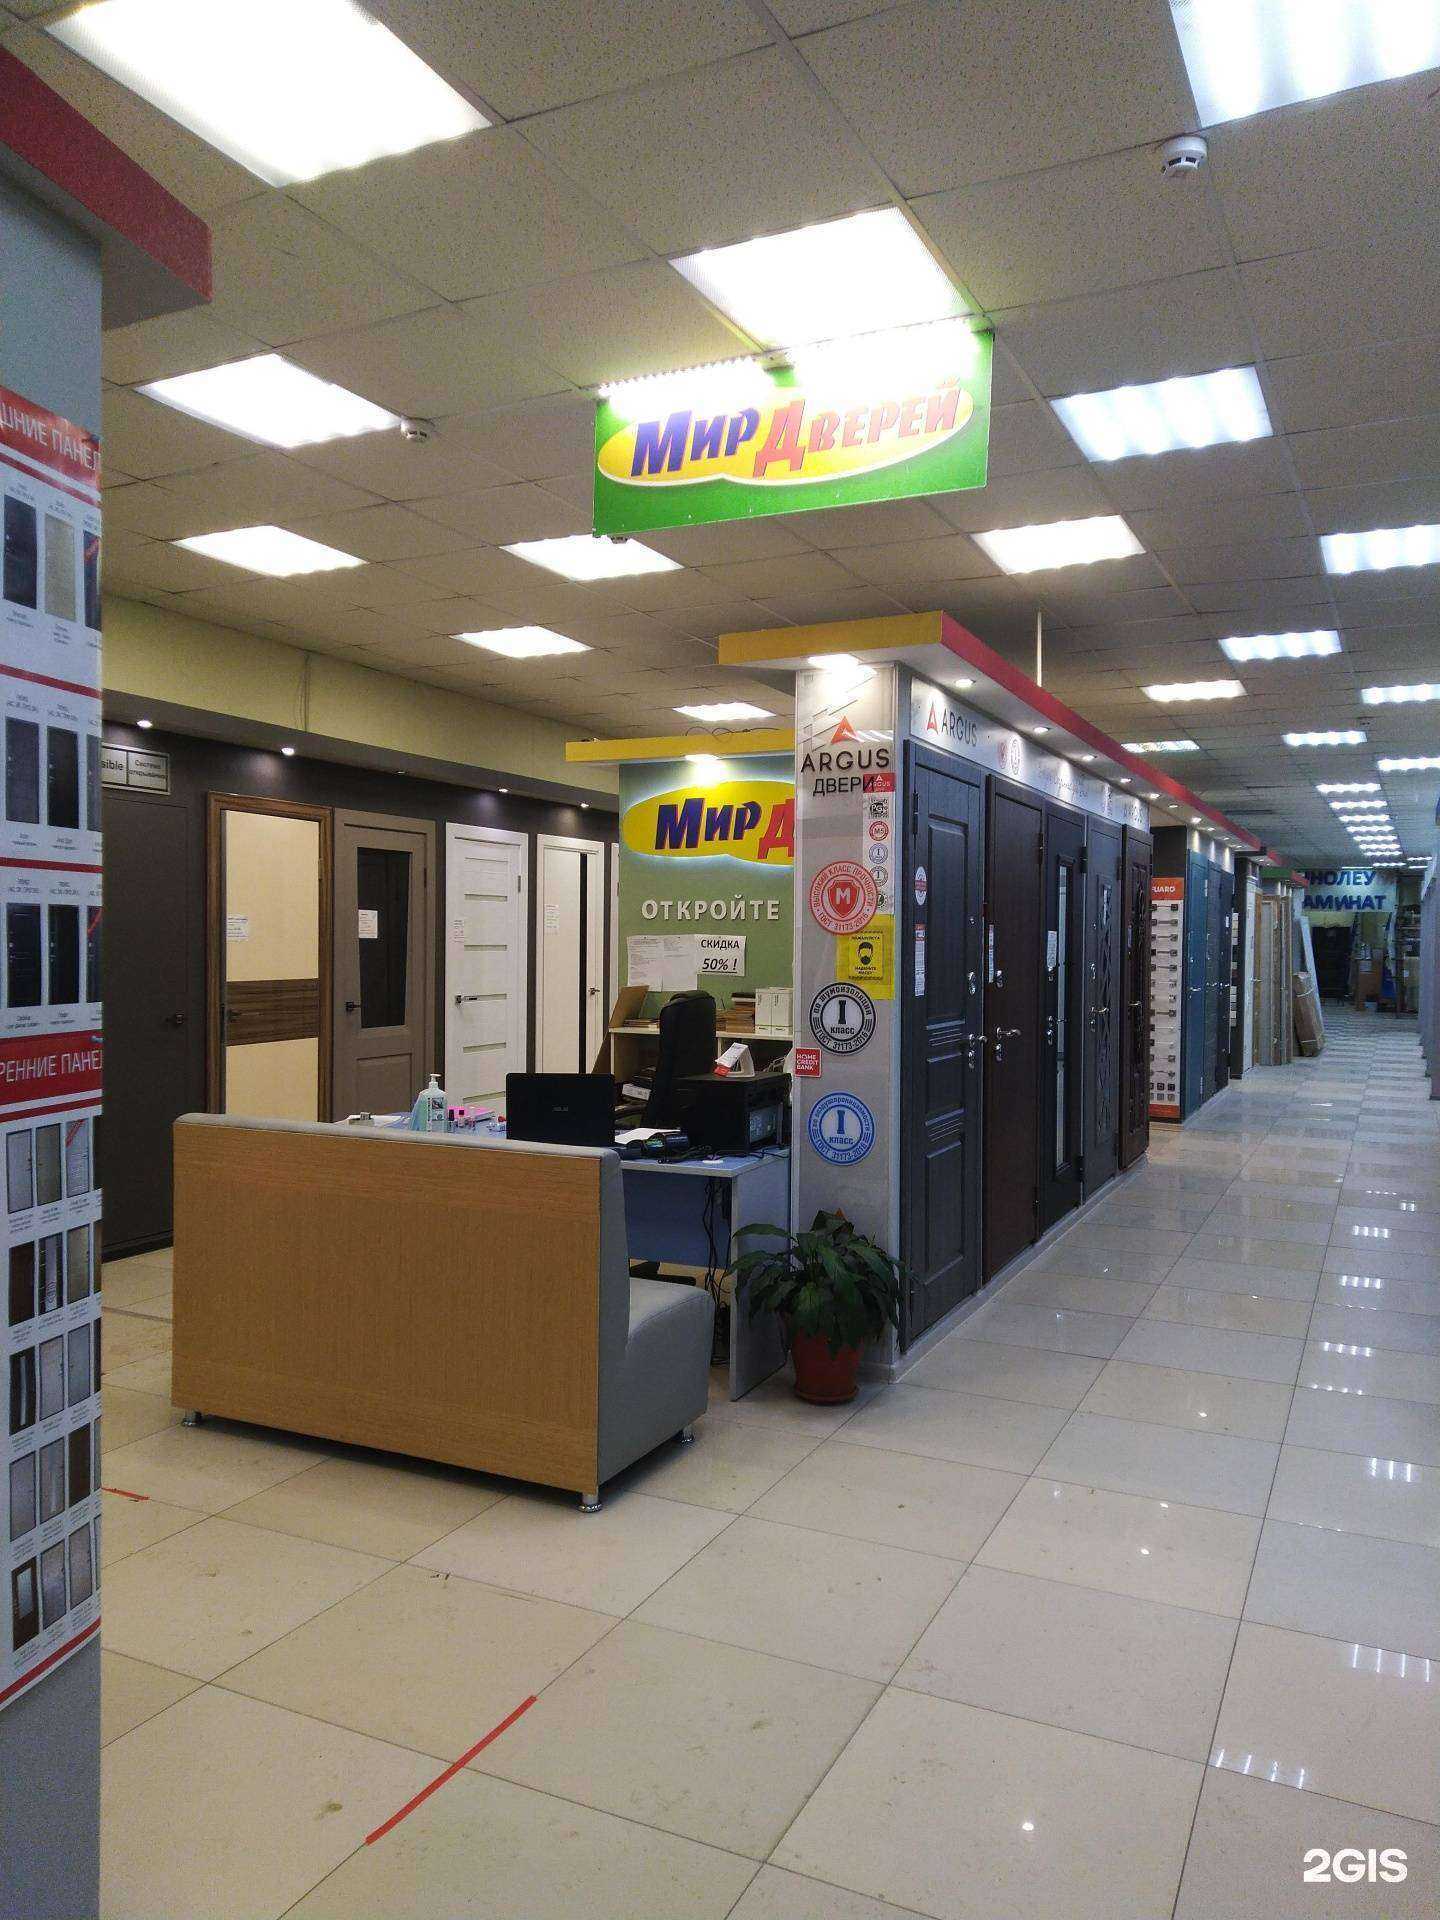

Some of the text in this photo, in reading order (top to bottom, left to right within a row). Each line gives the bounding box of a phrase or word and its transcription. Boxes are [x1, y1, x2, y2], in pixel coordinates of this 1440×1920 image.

[941, 709, 978, 748] ARGUS
[801, 748, 890, 773] ARGUS
[812, 775, 875, 797] ДВЕРИ
[813, 864, 875, 908] ВЫСОКИЙ КЛАСС ПРОЧНОСТИ
[641, 894, 781, 921] ОТКРОЙТЕ
[817, 912, 833, 927] ГОСТ
[701, 939, 740, 950] СКИДКА
[702, 958, 729, 971] 50%
[816, 1030, 868, 1051] ГОСТ 31173-2016
[816, 1139, 831, 1155] ГОСТ
